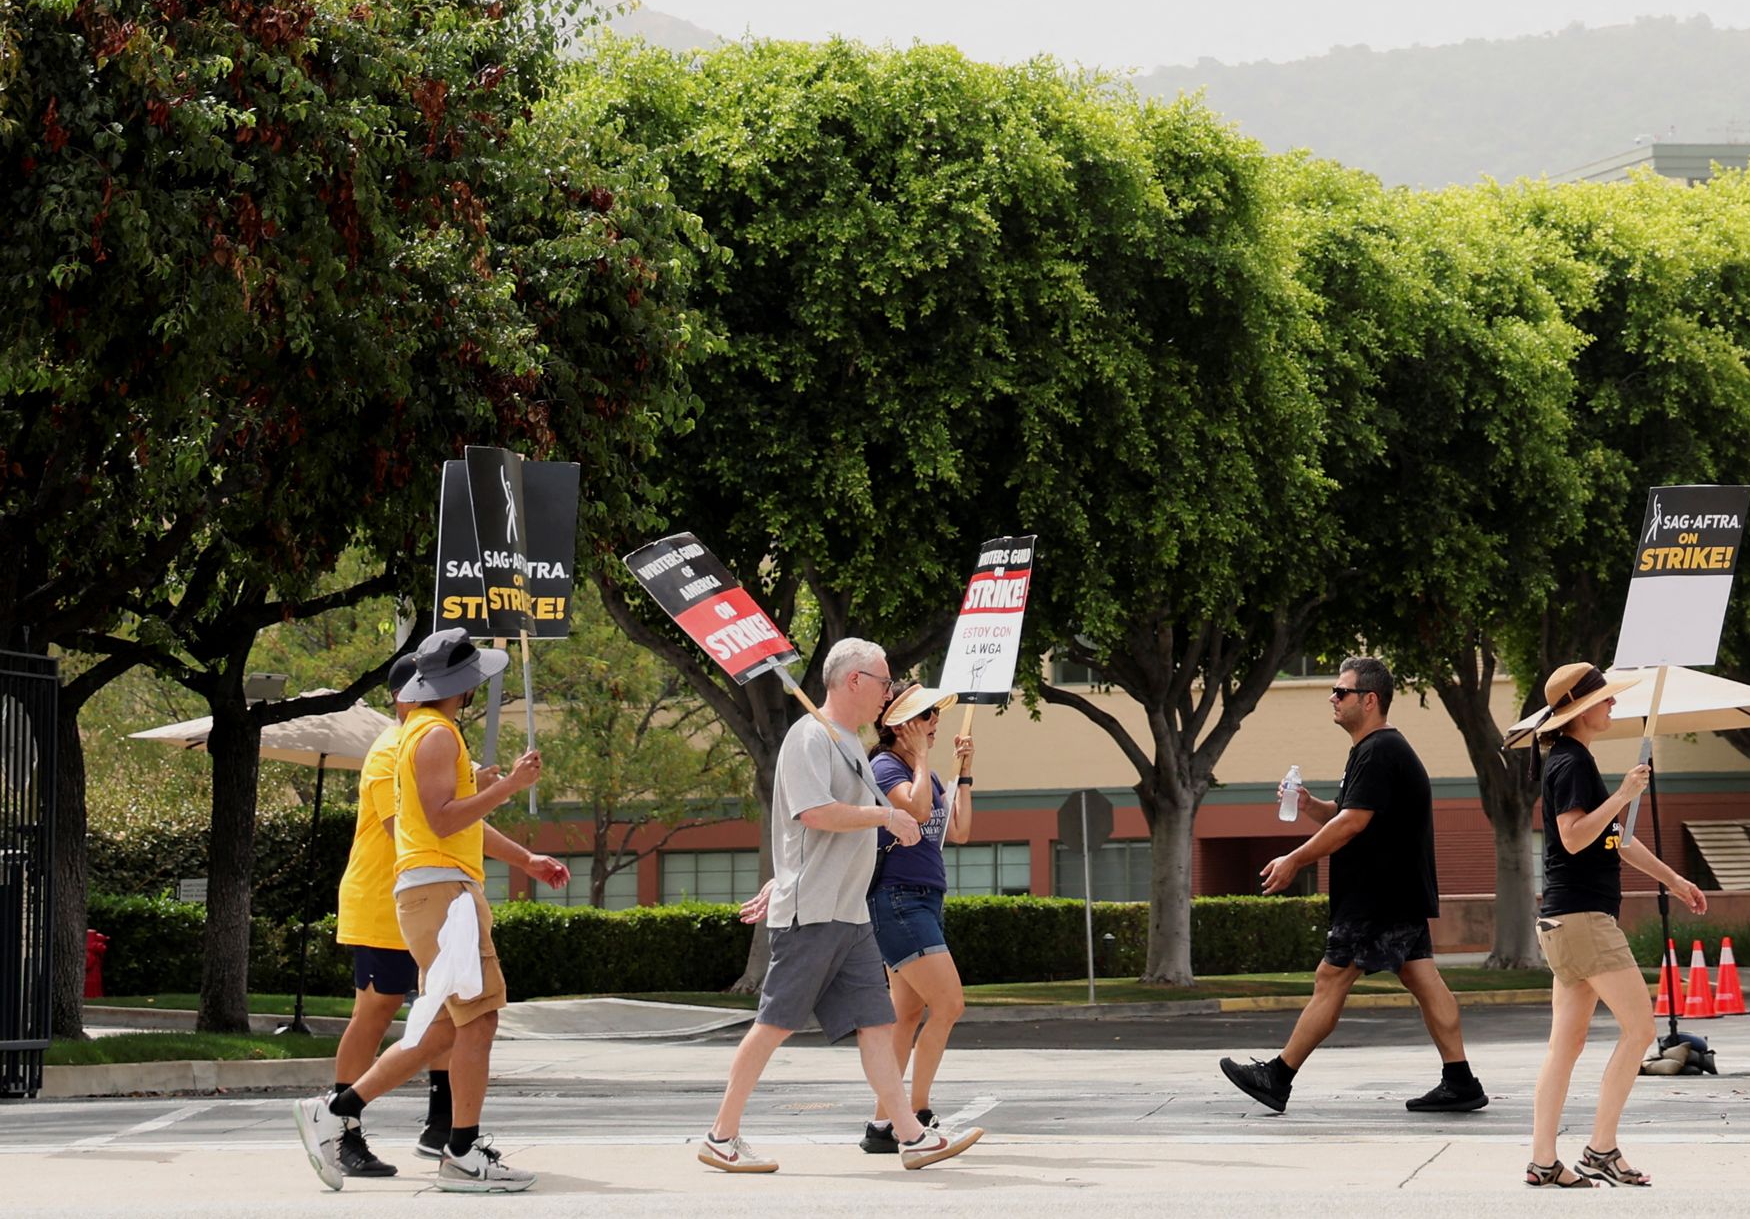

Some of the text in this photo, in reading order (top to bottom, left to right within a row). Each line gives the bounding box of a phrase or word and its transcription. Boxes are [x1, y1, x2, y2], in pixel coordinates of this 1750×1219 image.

[1678, 532, 1698, 545] ON
[637, 548, 685, 581] WRITERS
[1639, 546, 1734, 571] STRIKE!
[680, 565, 695, 578] OF
[993, 566, 1005, 577] ON
[678, 574, 722, 601] AMERICA
[964, 576, 1027, 610] STRIKE!
[714, 601, 738, 620] ON
[705, 612, 779, 661] STRIKE!
[963, 626, 1012, 640] ESTOY CON
[965, 643, 1002, 655] LA WGA
